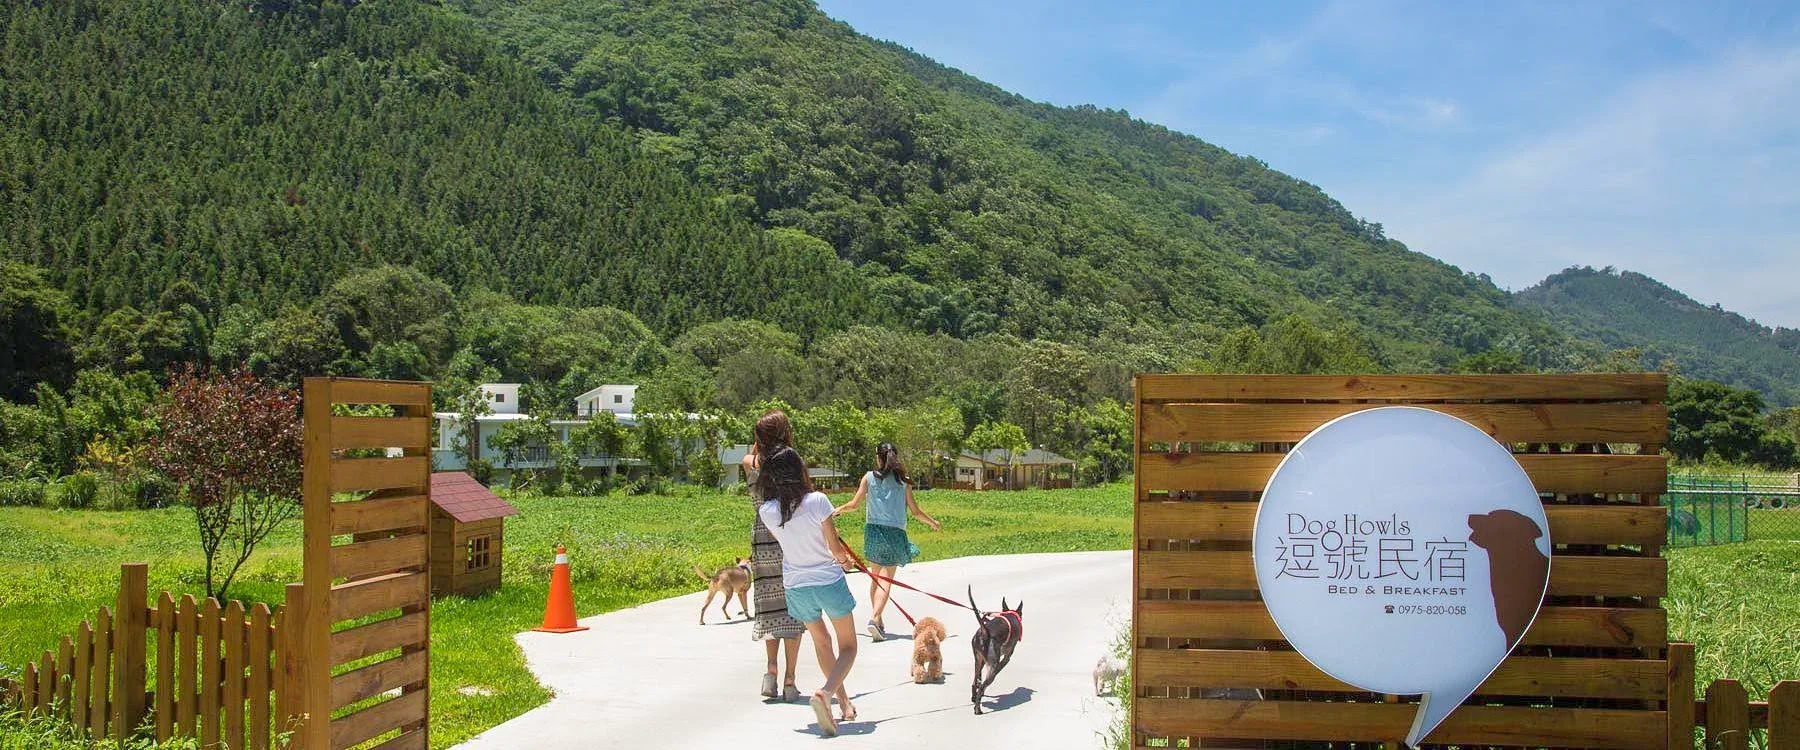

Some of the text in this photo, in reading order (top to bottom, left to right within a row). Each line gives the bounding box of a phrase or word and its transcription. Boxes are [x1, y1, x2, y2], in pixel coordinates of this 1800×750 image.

[1287, 513, 1411, 542] Dog Howls
[1275, 532, 1468, 582] 逗號民宿
[1328, 585, 1468, 596] BED & BREAKFAST
[1398, 605, 1467, 615] 0975-820-058
